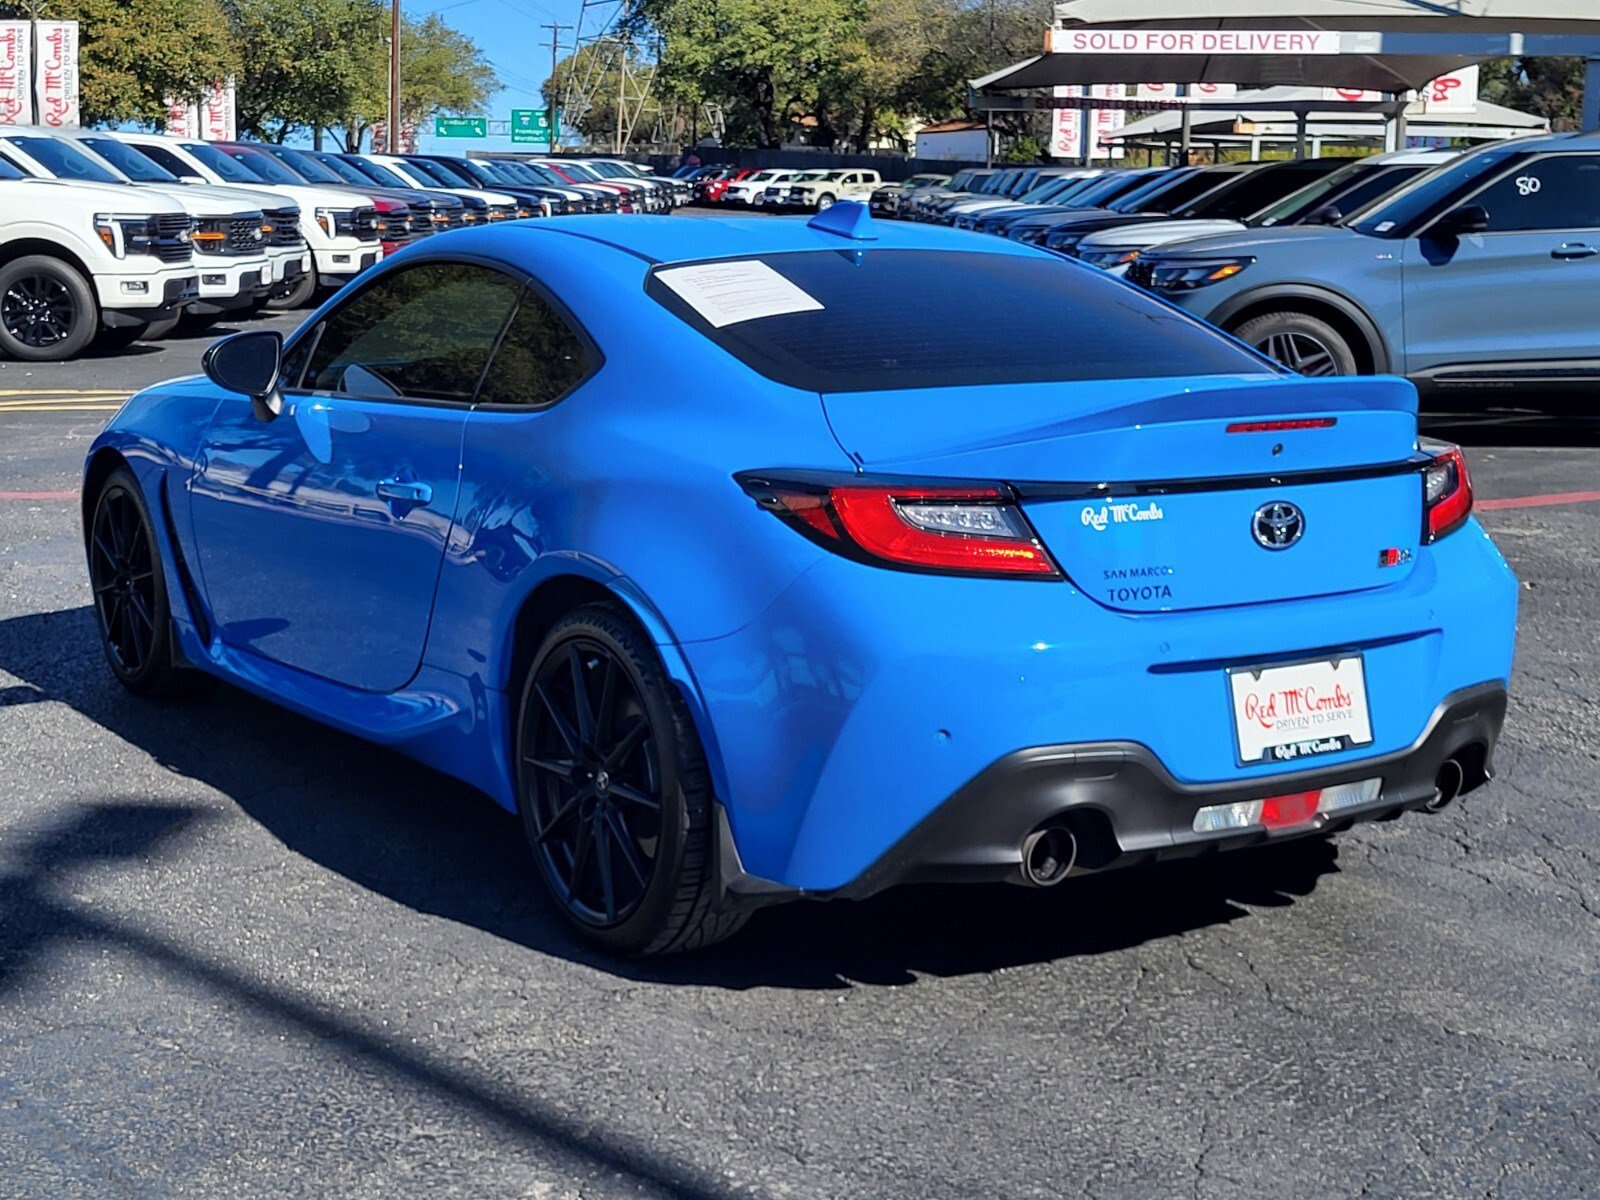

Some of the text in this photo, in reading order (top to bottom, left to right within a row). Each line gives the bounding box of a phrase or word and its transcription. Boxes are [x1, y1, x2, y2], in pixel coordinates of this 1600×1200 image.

[1073, 33, 1321, 50] SOLD FOR DELIVERY
[17, 27, 25, 100] DRIVEN TO SERVE
[63, 27, 71, 100] DRIVEN TO SERVE
[44, 27, 69, 127] Red McCombs
[0, 96, 22, 126] Red
[1035, 98, 1187, 110] SOLD FOR DELIVERY
[1515, 176, 1541, 195] 80
[1081, 506, 1108, 531] Red
[1103, 569, 1127, 580] SAN
[1107, 585, 1172, 602] TOYOTA
[1245, 683, 1352, 729] Red McCombs
[1276, 709, 1353, 730] DRIVEN TO SERVE
